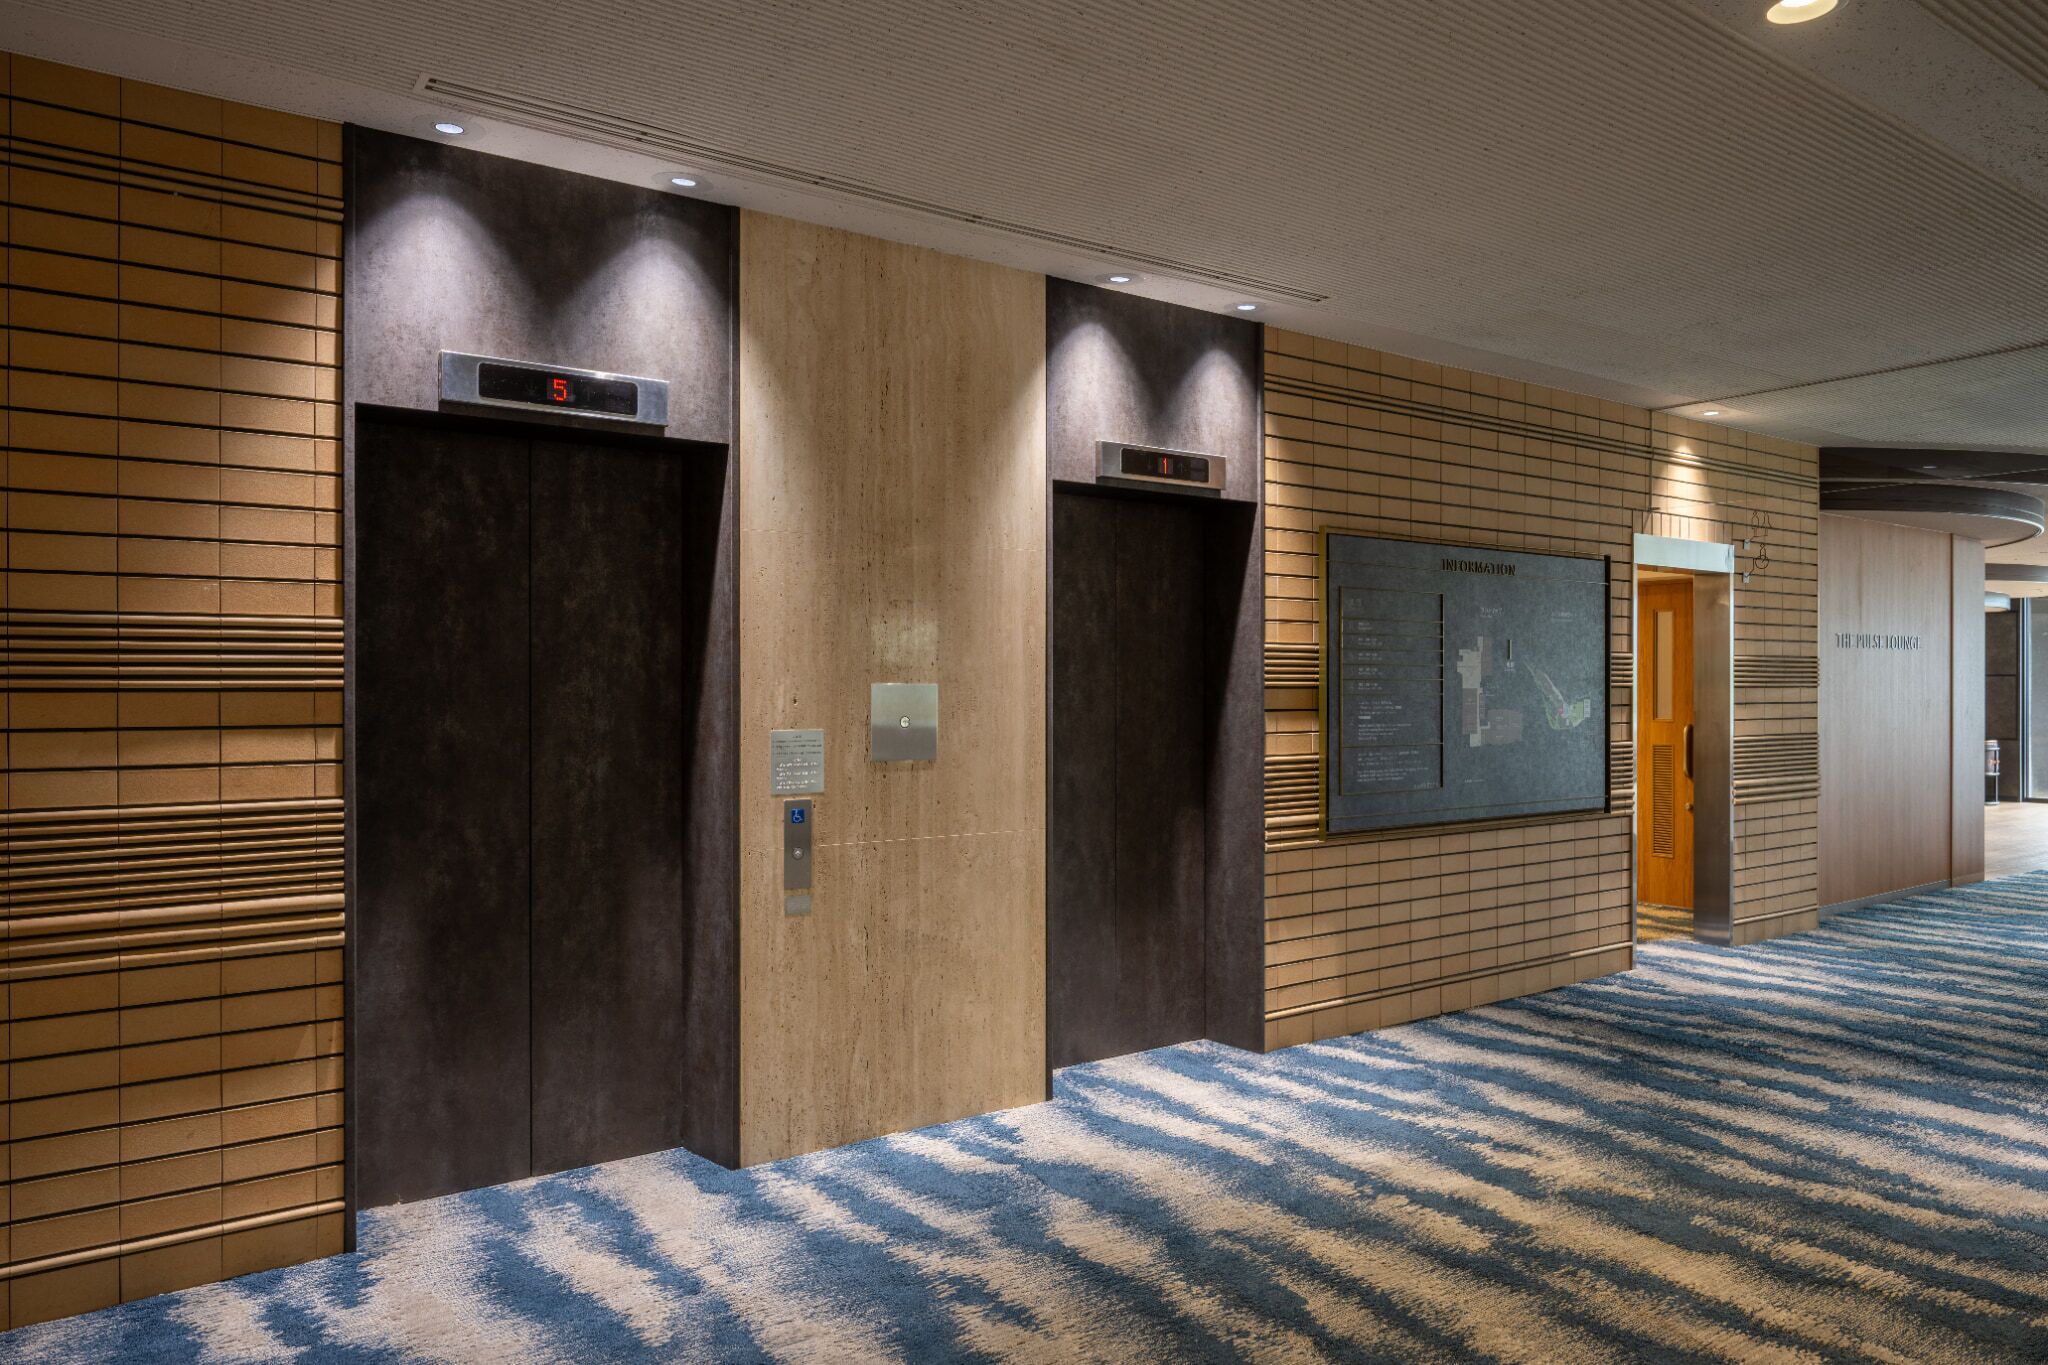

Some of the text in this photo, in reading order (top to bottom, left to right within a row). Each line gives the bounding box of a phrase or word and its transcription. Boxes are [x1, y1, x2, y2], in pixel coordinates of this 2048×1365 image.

[553, 378, 567, 402] 5
[1441, 558, 1516, 577] INFORMATION
[1835, 632, 1922, 651] THE PULSE LOUNGE
